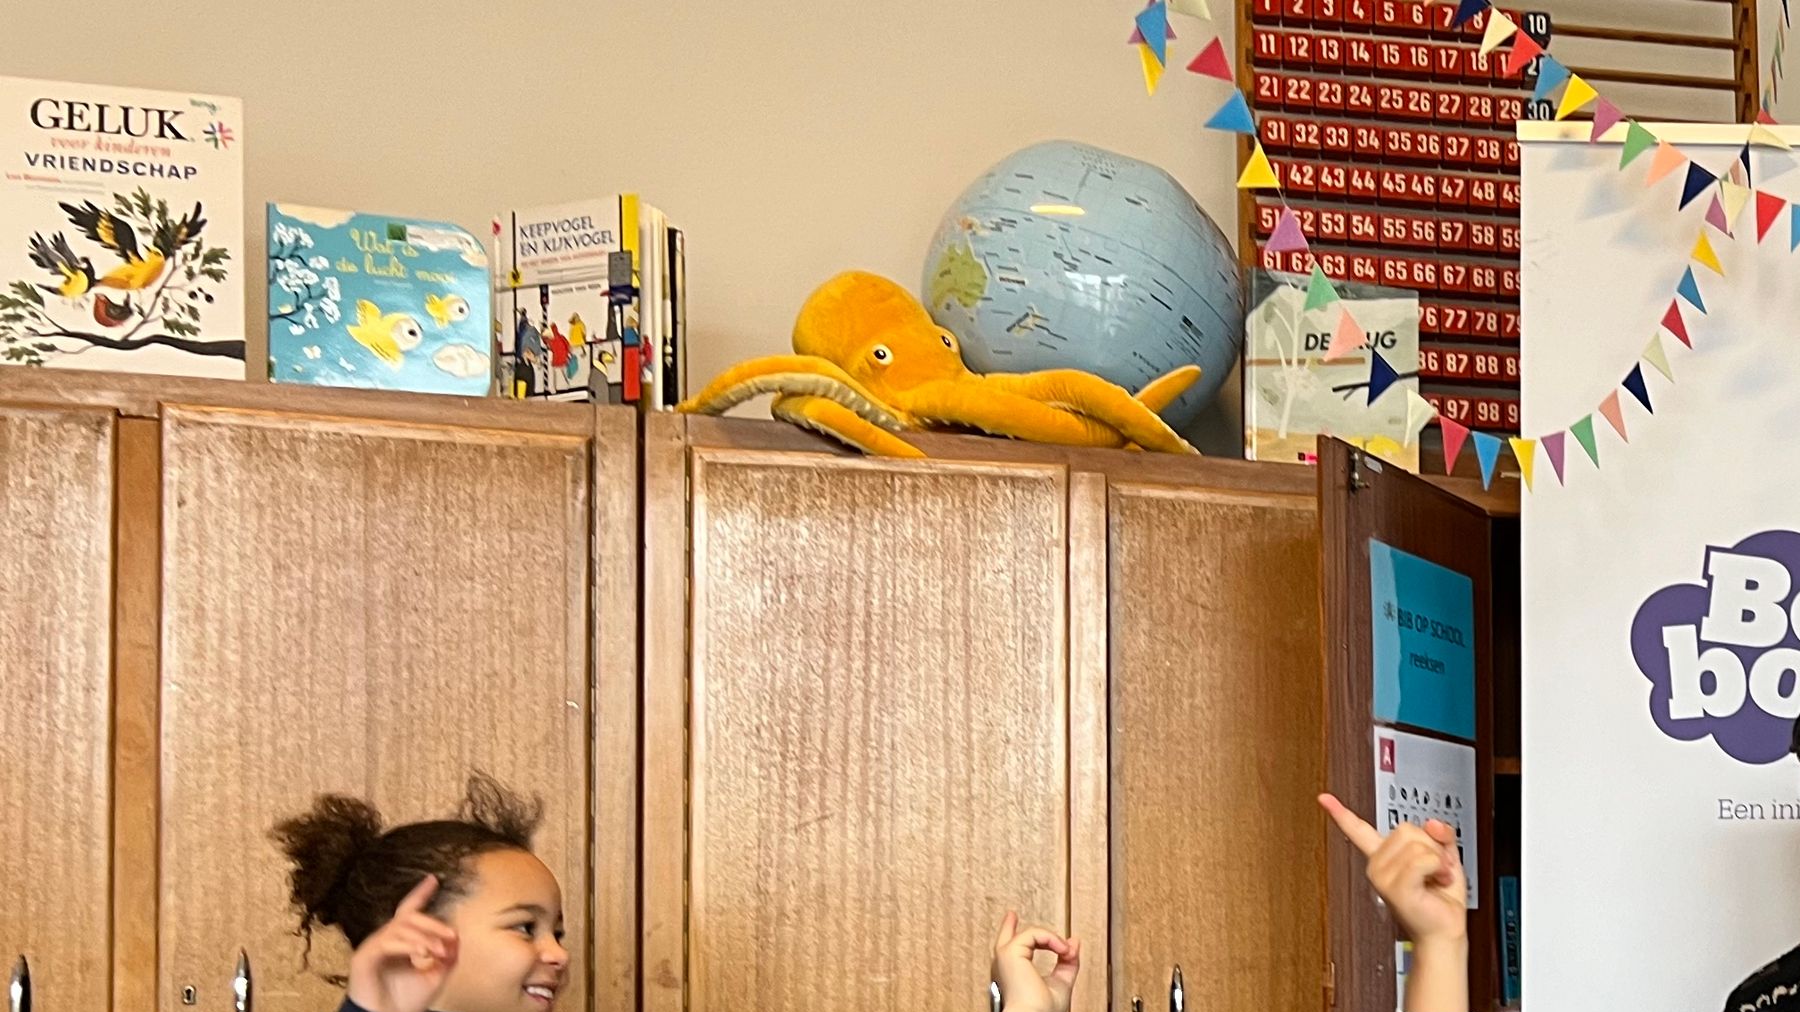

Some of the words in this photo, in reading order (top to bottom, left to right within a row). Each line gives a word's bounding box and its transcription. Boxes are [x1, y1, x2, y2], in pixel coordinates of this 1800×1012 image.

[1293, 0, 1304, 14] 2
[1323, 0, 1334, 16] 3
[1353, 0, 1364, 19] 4
[1383, 1, 1395, 21] 5
[1412, 4, 1423, 24] 6
[1442, 6, 1453, 27] 7
[1473, 10, 1484, 29] 8
[1527, 14, 1547, 35] 10
[1260, 33, 1276, 54] 11
[1289, 36, 1309, 57] 12
[1320, 38, 1339, 60] 13
[1351, 41, 1370, 62] 14
[1381, 43, 1400, 64] 15
[1410, 46, 1428, 67] 16
[1440, 48, 1458, 69] 17
[1470, 51, 1488, 71] 18
[1260, 75, 1278, 97] 21
[1287, 78, 1310, 100] 22
[1319, 82, 1341, 104] 23
[1349, 85, 1372, 106] 24
[1380, 87, 1403, 109] 25
[1408, 90, 1431, 112] 26
[1439, 93, 1460, 114] 27
[1469, 96, 1491, 118] 28
[1499, 99, 1521, 120] 29
[1528, 101, 1550, 121] 30
[30, 97, 190, 142] GELUK
[50, 135, 89, 150] voor
[94, 135, 172, 158] kinderen
[1267, 120, 1285, 141] 31
[1295, 123, 1319, 144] 32
[1326, 126, 1348, 147] 33
[1357, 128, 1380, 149] 34
[1388, 131, 1412, 151] 35
[1417, 133, 1440, 154] 36
[1447, 136, 1470, 157] 37
[1477, 139, 1500, 159] 38
[24, 151, 198, 180] VRIENDSCHAP
[1290, 164, 1314, 185] 42
[1321, 166, 1345, 188] 43
[1352, 169, 1376, 191] 44
[1382, 172, 1406, 193] 45
[1411, 174, 1435, 196] 46
[1441, 177, 1465, 198] 47
[1472, 180, 1495, 201] 48
[519, 215, 595, 241] KEEPVOGEL
[1261, 208, 1280, 228] 51
[1292, 210, 1315, 232] 52
[1321, 212, 1345, 234] 53
[1352, 215, 1375, 237] 54
[1383, 218, 1406, 239] 55
[1412, 220, 1435, 241] 56
[1441, 222, 1464, 242] 57
[1472, 224, 1494, 245] 58
[519, 240, 539, 257] EN
[543, 229, 616, 254] KIJKVOGEL
[1263, 250, 1281, 270] 61
[1291, 250, 1315, 272] 62
[1322, 254, 1345, 275] 63
[1353, 257, 1376, 278] 64
[1384, 260, 1408, 280] 65
[1413, 262, 1436, 284] 66
[1443, 265, 1466, 285] 67
[1472, 267, 1495, 288] 68
[1444, 308, 1467, 329] 77
[1474, 311, 1497, 332] 78
[1304, 332, 1331, 351] DE
[1445, 353, 1469, 374] 87
[1475, 355, 1499, 375] 88
[1506, 357, 1519, 376] 8
[1446, 400, 1469, 420] 97
[1477, 402, 1500, 422] 98
[1383, 745, 1392, 766] A
[1717, 798, 1765, 820] Een
